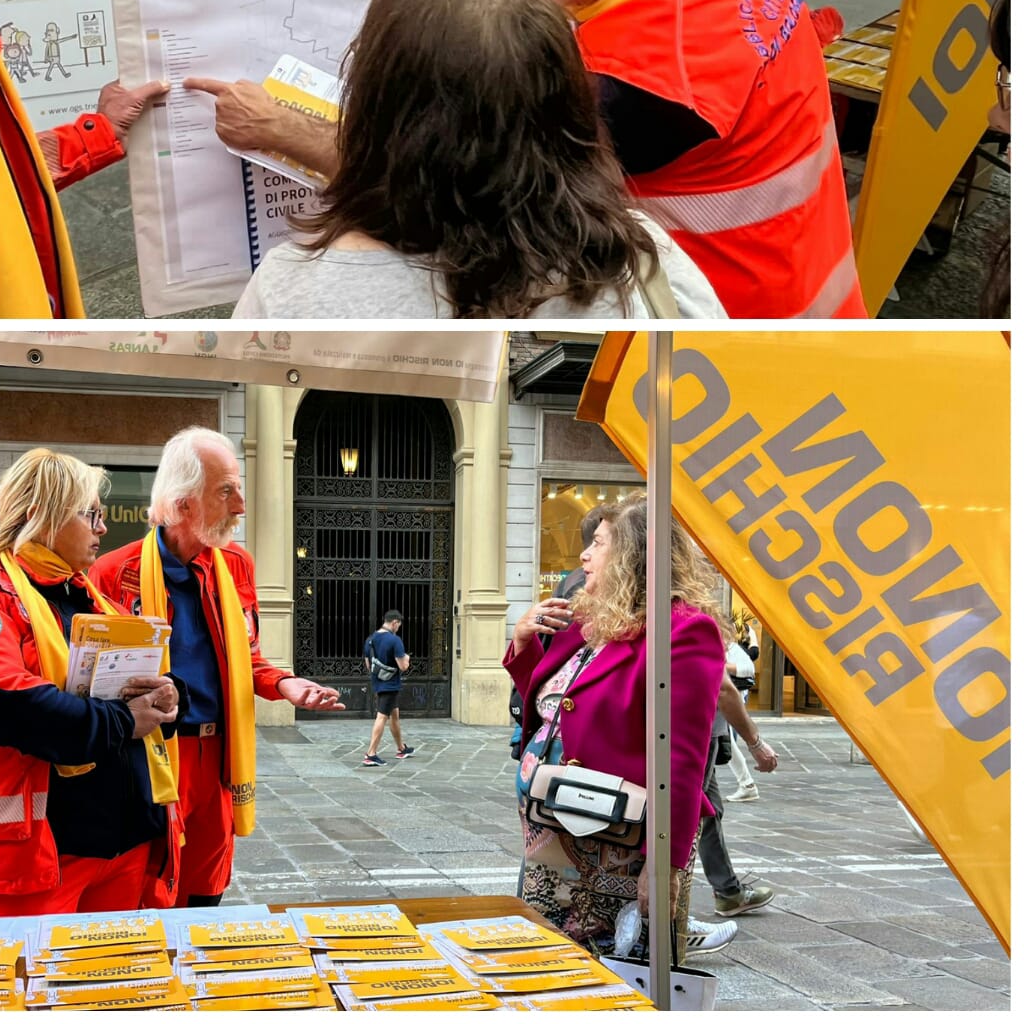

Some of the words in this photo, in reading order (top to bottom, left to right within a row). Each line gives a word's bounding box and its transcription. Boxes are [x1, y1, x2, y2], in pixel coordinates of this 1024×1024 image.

[265, 192, 278, 204] DI
[281, 186, 314, 202] PROT
[266, 202, 305, 219] CIVILE
